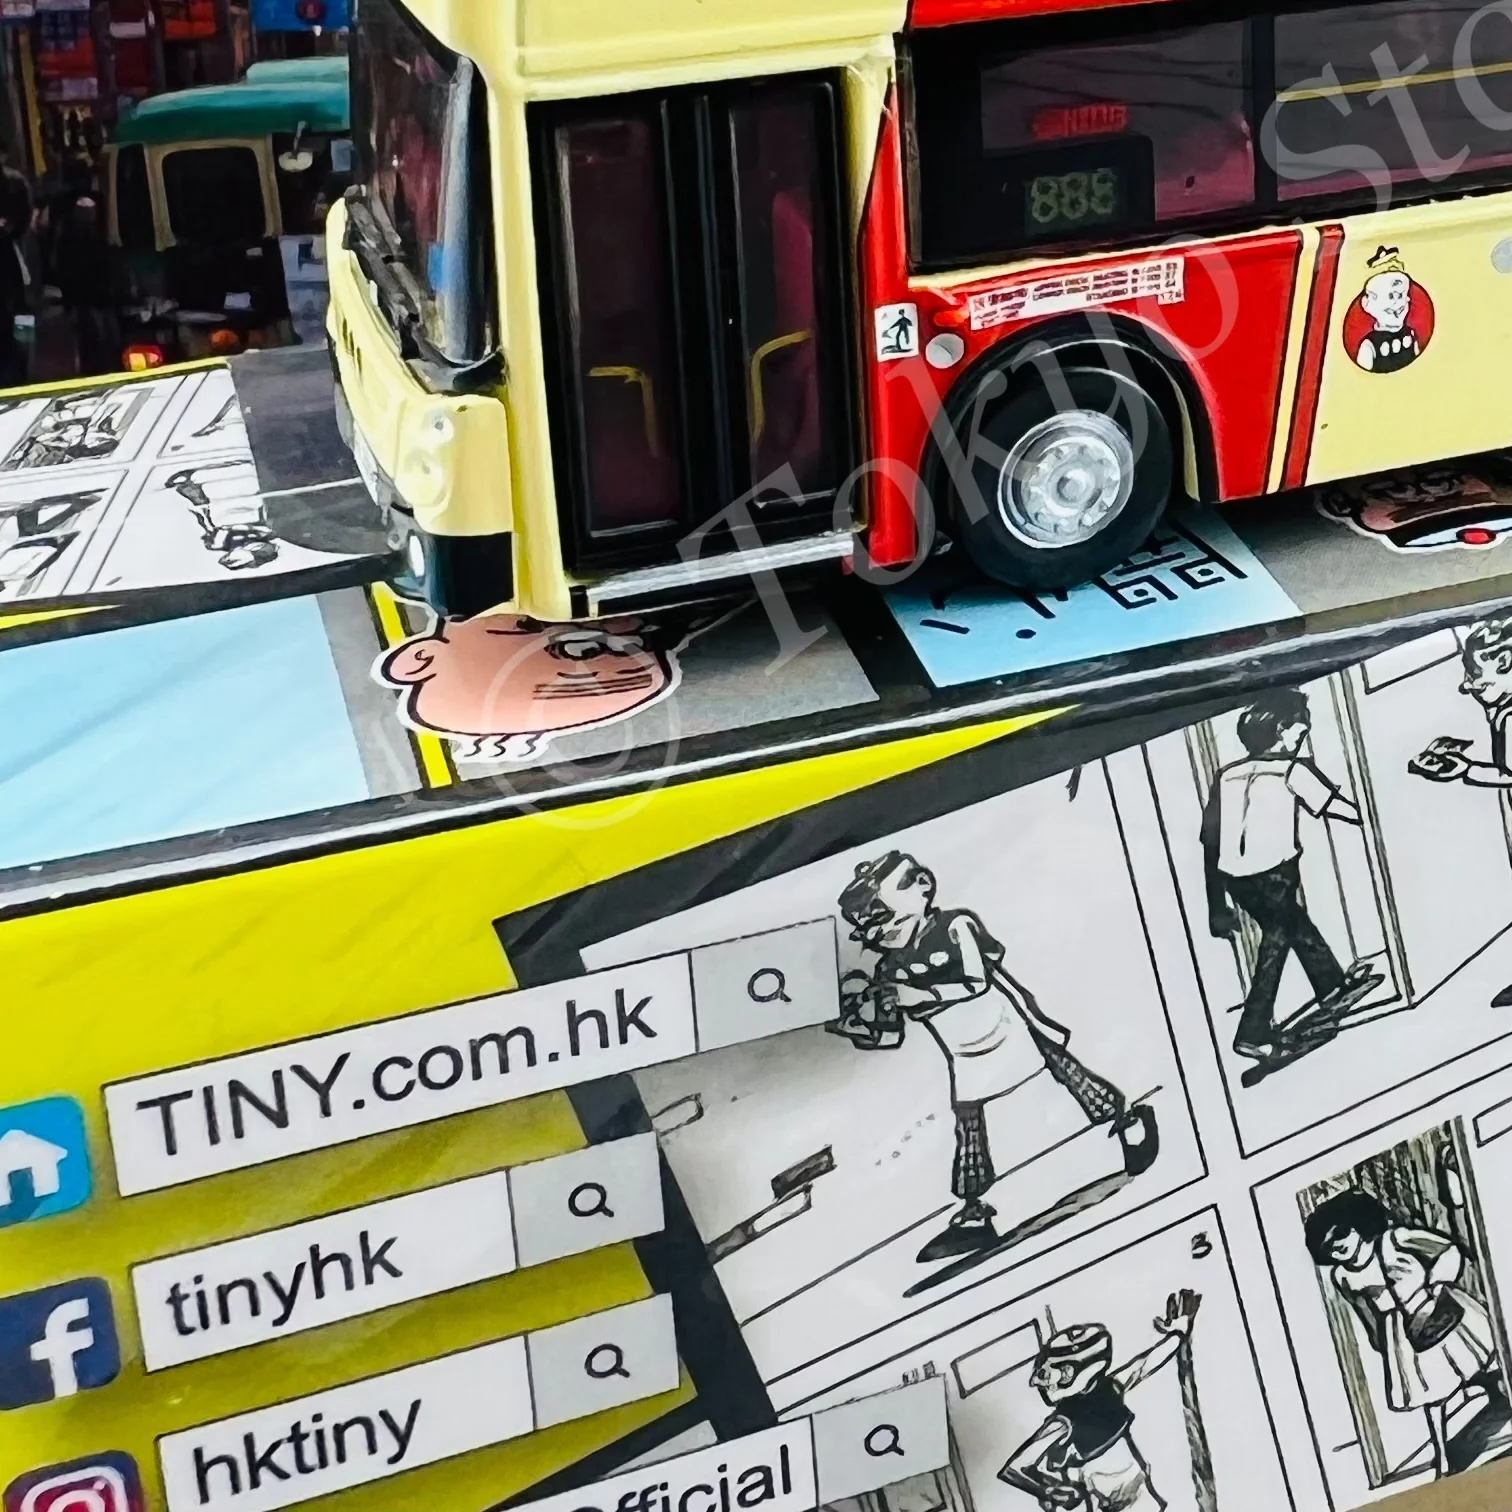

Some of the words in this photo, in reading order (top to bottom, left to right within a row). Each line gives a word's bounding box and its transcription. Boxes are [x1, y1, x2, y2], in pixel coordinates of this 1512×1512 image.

[137, 988, 658, 1156] TINY.com.hk
[165, 1230, 404, 1338] tinyhk
[193, 1398, 423, 1508] hktiny
[572, 1444, 792, 1512] fficial
